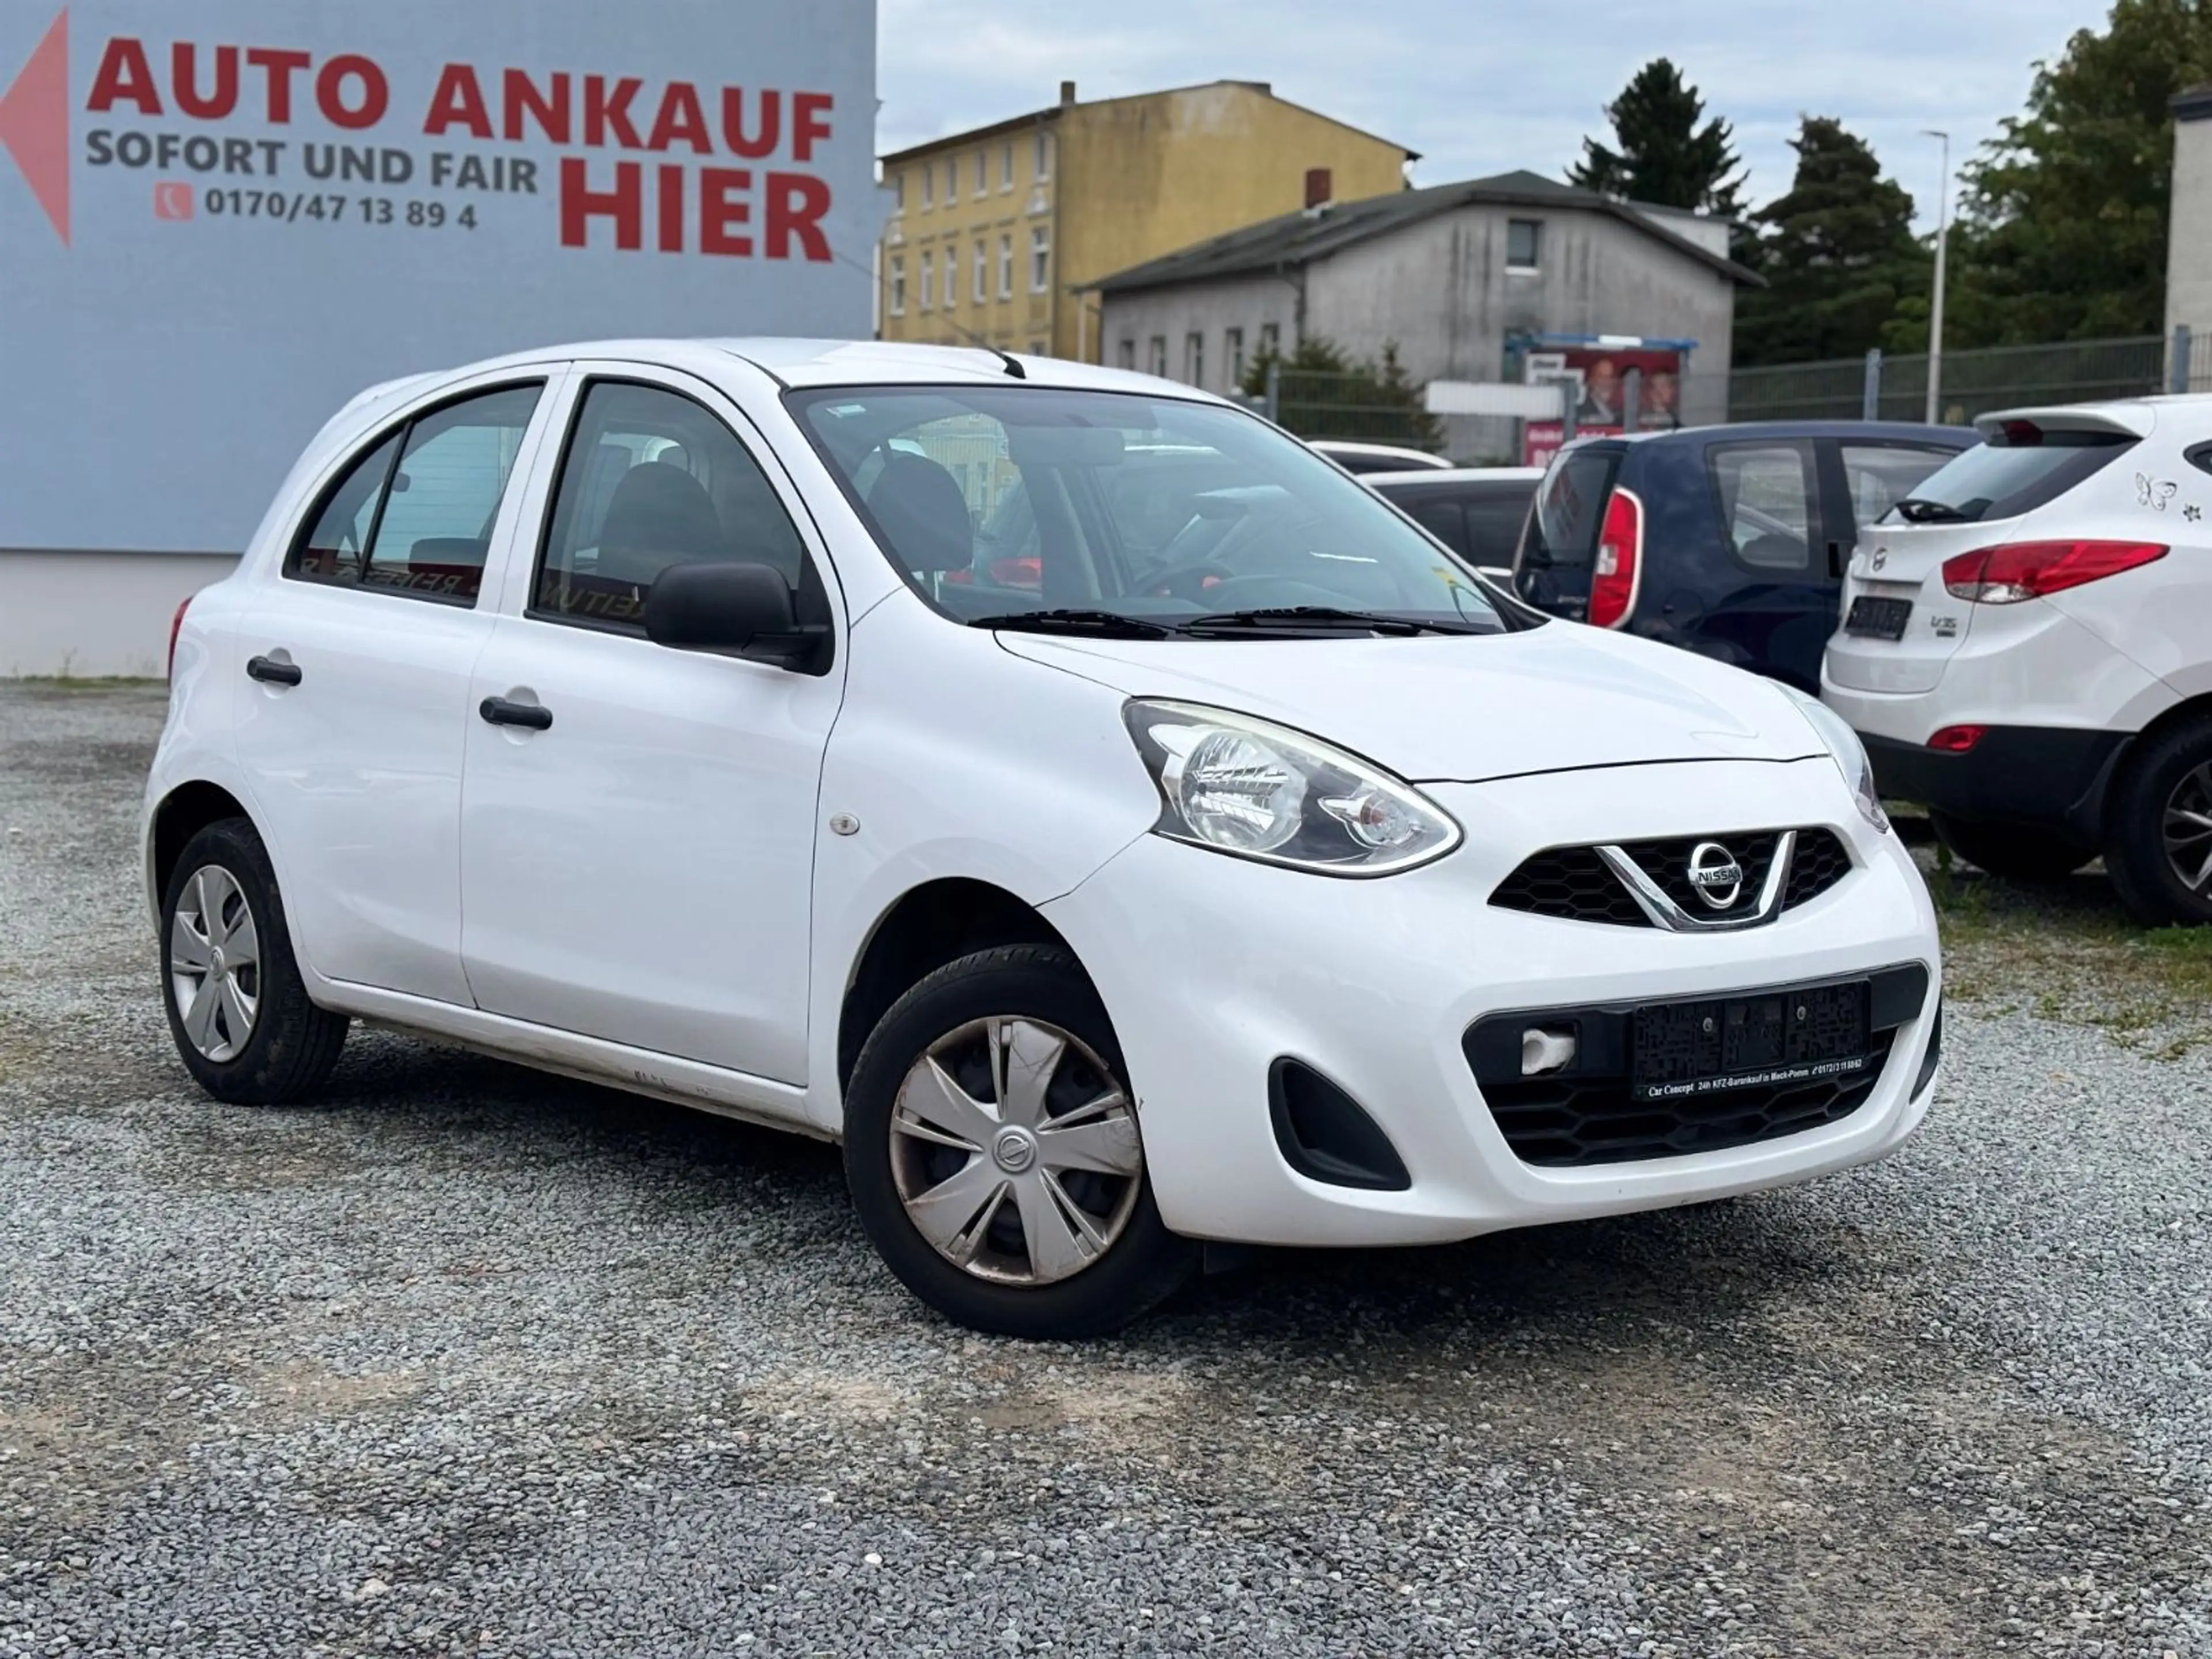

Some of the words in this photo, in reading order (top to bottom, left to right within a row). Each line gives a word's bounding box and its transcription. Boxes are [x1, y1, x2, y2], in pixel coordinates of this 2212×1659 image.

[86, 37, 389, 130] AUTO
[423, 63, 834, 162] ANKAUF
[86, 128, 286, 176] SOFORT
[303, 143, 413, 187] UND
[431, 152, 537, 194] FAIR
[205, 188, 346, 223] 0170/47
[359, 197, 393, 224] 13
[406, 202, 446, 228] 89
[457, 204, 478, 230] 4
[560, 156, 833, 263] HIER
[1698, 866, 1739, 882] NISSAN
[1648, 1086, 1662, 1097] Car
[1664, 1082, 1694, 1095] Concept
